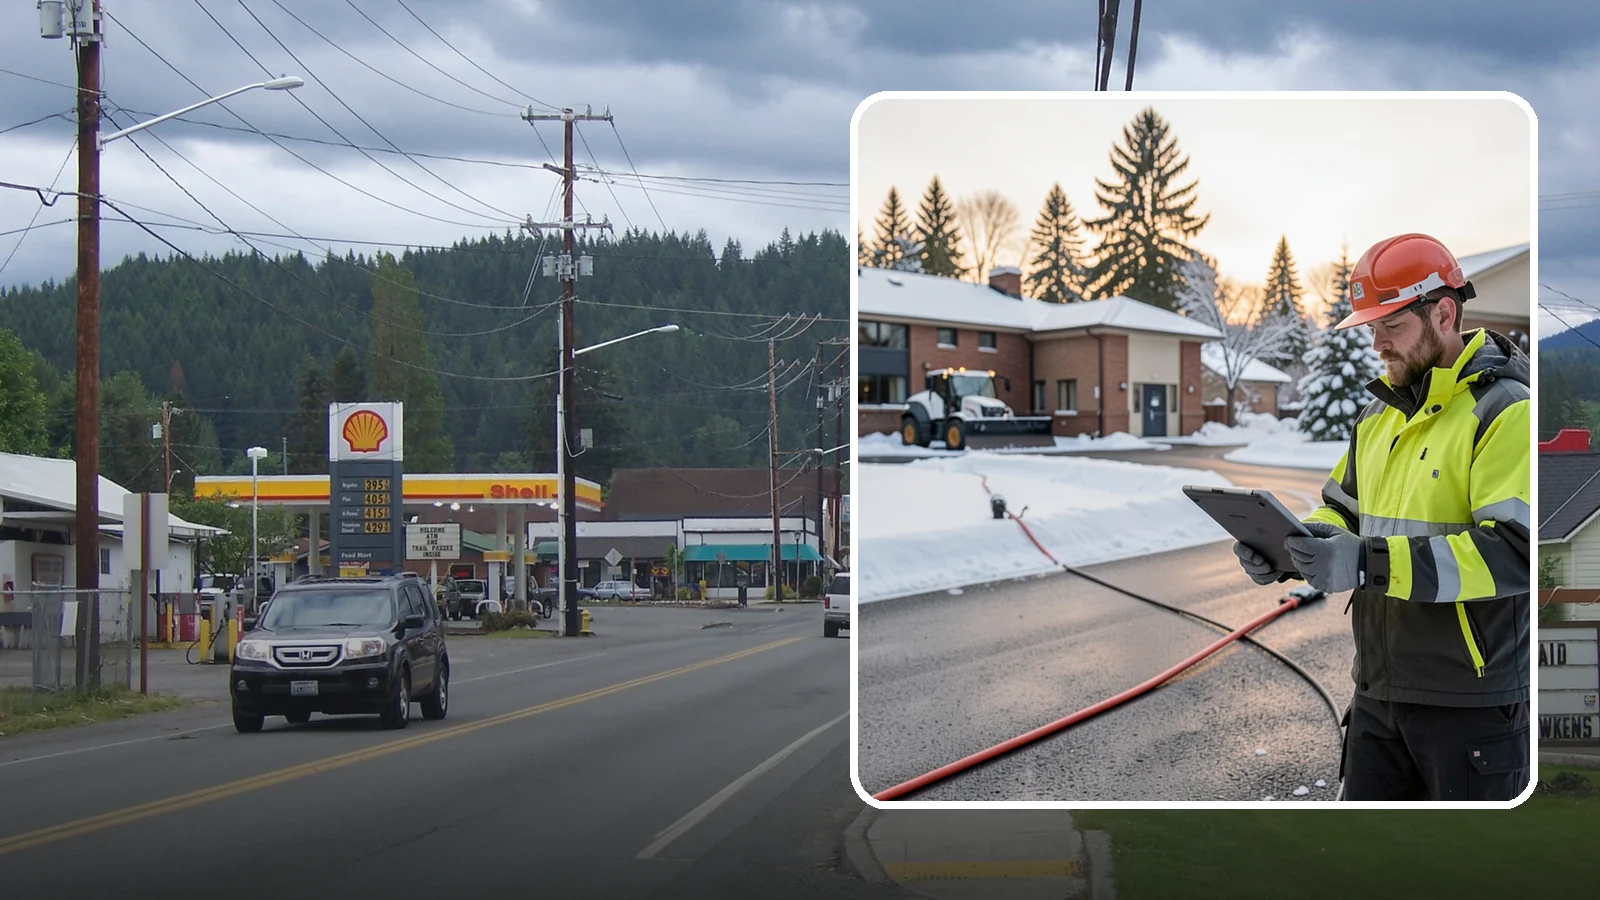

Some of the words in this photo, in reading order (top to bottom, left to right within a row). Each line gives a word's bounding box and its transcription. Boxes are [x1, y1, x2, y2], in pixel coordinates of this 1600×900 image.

[366, 480, 383, 490] 395
[490, 484, 547, 499] Shell
[366, 494, 383, 504] 405
[366, 508, 383, 518] 415
[366, 522, 383, 532] 429
[1538, 643, 1566, 665] AID
